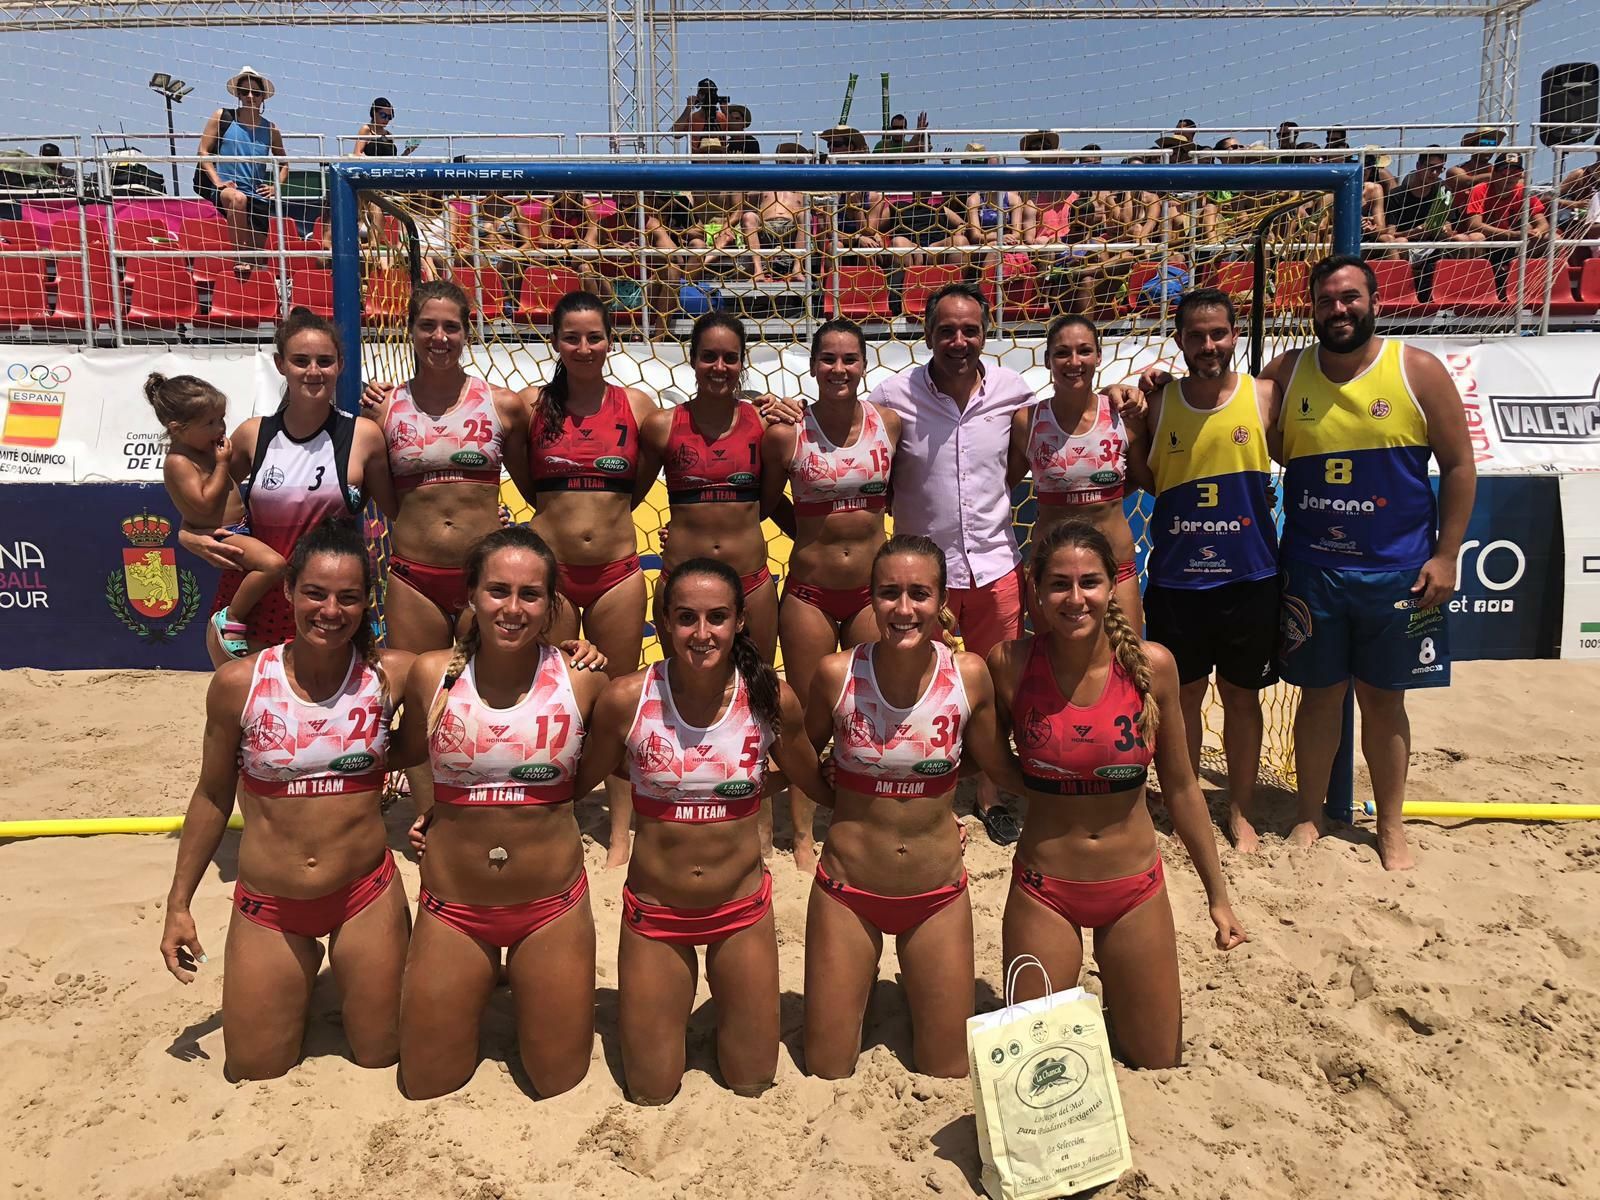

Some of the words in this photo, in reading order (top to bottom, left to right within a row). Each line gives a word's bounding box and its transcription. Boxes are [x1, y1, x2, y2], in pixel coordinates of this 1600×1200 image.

[371, 168, 427, 178] SPORT
[434, 168, 525, 179] TRANSFER
[13, 391, 59, 403] ESPAÑA
[463, 418, 493, 443] 25
[615, 423, 628, 447] 7
[20, 449, 66, 465] OLÍMPICO
[748, 443, 757, 465] 1
[869, 447, 890, 473] 15
[1099, 439, 1123, 462] 37
[127, 457, 152, 470] DE
[1324, 458, 1353, 485] 8
[308, 465, 326, 491] 3
[567, 478, 581, 489] AM
[584, 477, 605, 489] TEAM
[848, 498, 868, 509] TEAM
[1081, 491, 1102, 502] TEAM
[1196, 483, 1219, 508] 3
[1298, 489, 1375, 512] jarana
[1168, 516, 1241, 535] jarana
[0, 591, 50, 609] OUR
[1418, 636, 1436, 665] 8
[347, 705, 384, 741] 27
[535, 714, 571, 750] 17
[930, 714, 961, 748] 31
[738, 735, 761, 768] 5
[286, 781, 307, 795] AM
[311, 778, 345, 794] TEAM
[468, 787, 488, 802] AM
[492, 787, 526, 802] TEAM
[875, 780, 894, 794] AM
[896, 782, 925, 794] TEAM
[1060, 781, 1078, 793] AM
[1081, 781, 1111, 793] TEAM
[675, 806, 694, 819] AM
[697, 805, 727, 819] TEAM
[240, 896, 264, 917] 27
[1016, 1126, 1037, 1135] para
[1068, 1098, 1103, 1125] Exigentes
[1058, 1103, 1070, 1116] del
[1070, 1099, 1085, 1112] Mar
[1061, 1153, 1070, 1161] en
